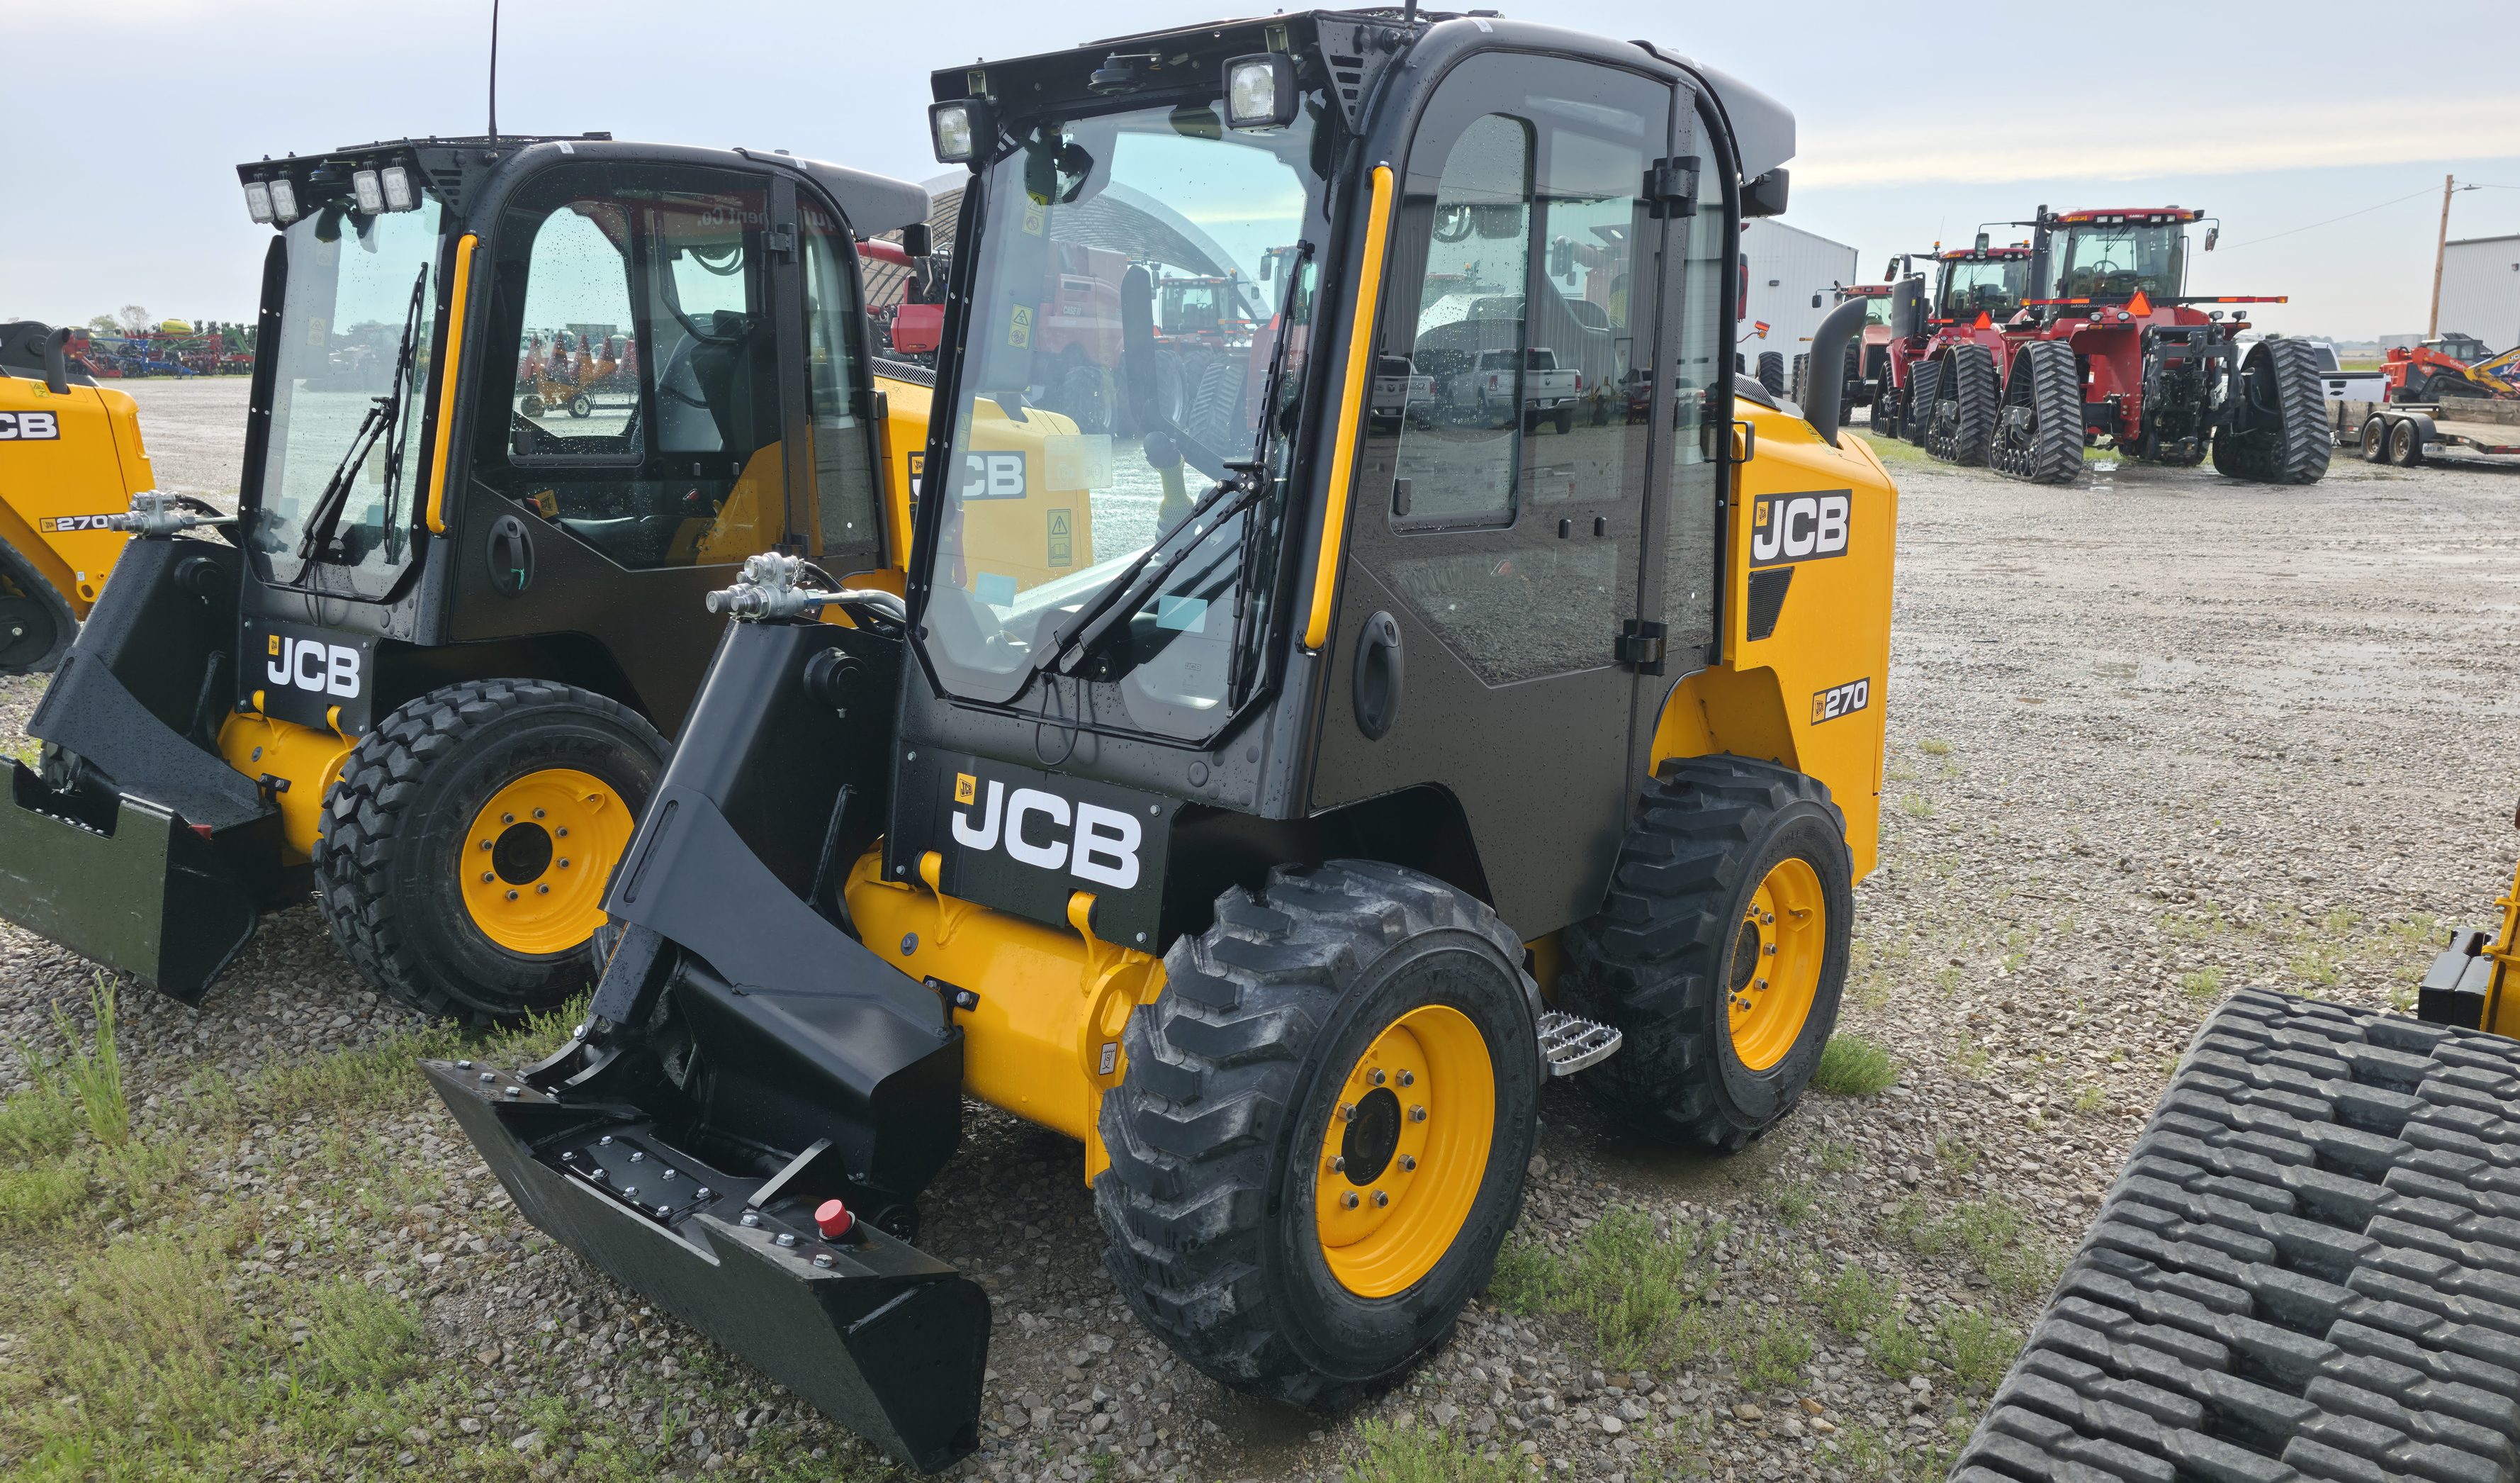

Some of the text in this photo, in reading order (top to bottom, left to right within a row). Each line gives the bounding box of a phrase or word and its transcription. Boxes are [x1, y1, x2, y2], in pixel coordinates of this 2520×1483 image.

[2509, 353, 2520, 362] JC
[0, 413, 57, 439] CB
[912, 456, 1023, 496] CB
[1754, 496, 1848, 560] JCB
[268, 637, 360, 698] JCB
[1185, 662, 1201, 671] JCB
[1825, 681, 1867, 719] 270
[960, 781, 972, 795] JCB
[952, 780, 1142, 890] JCB
